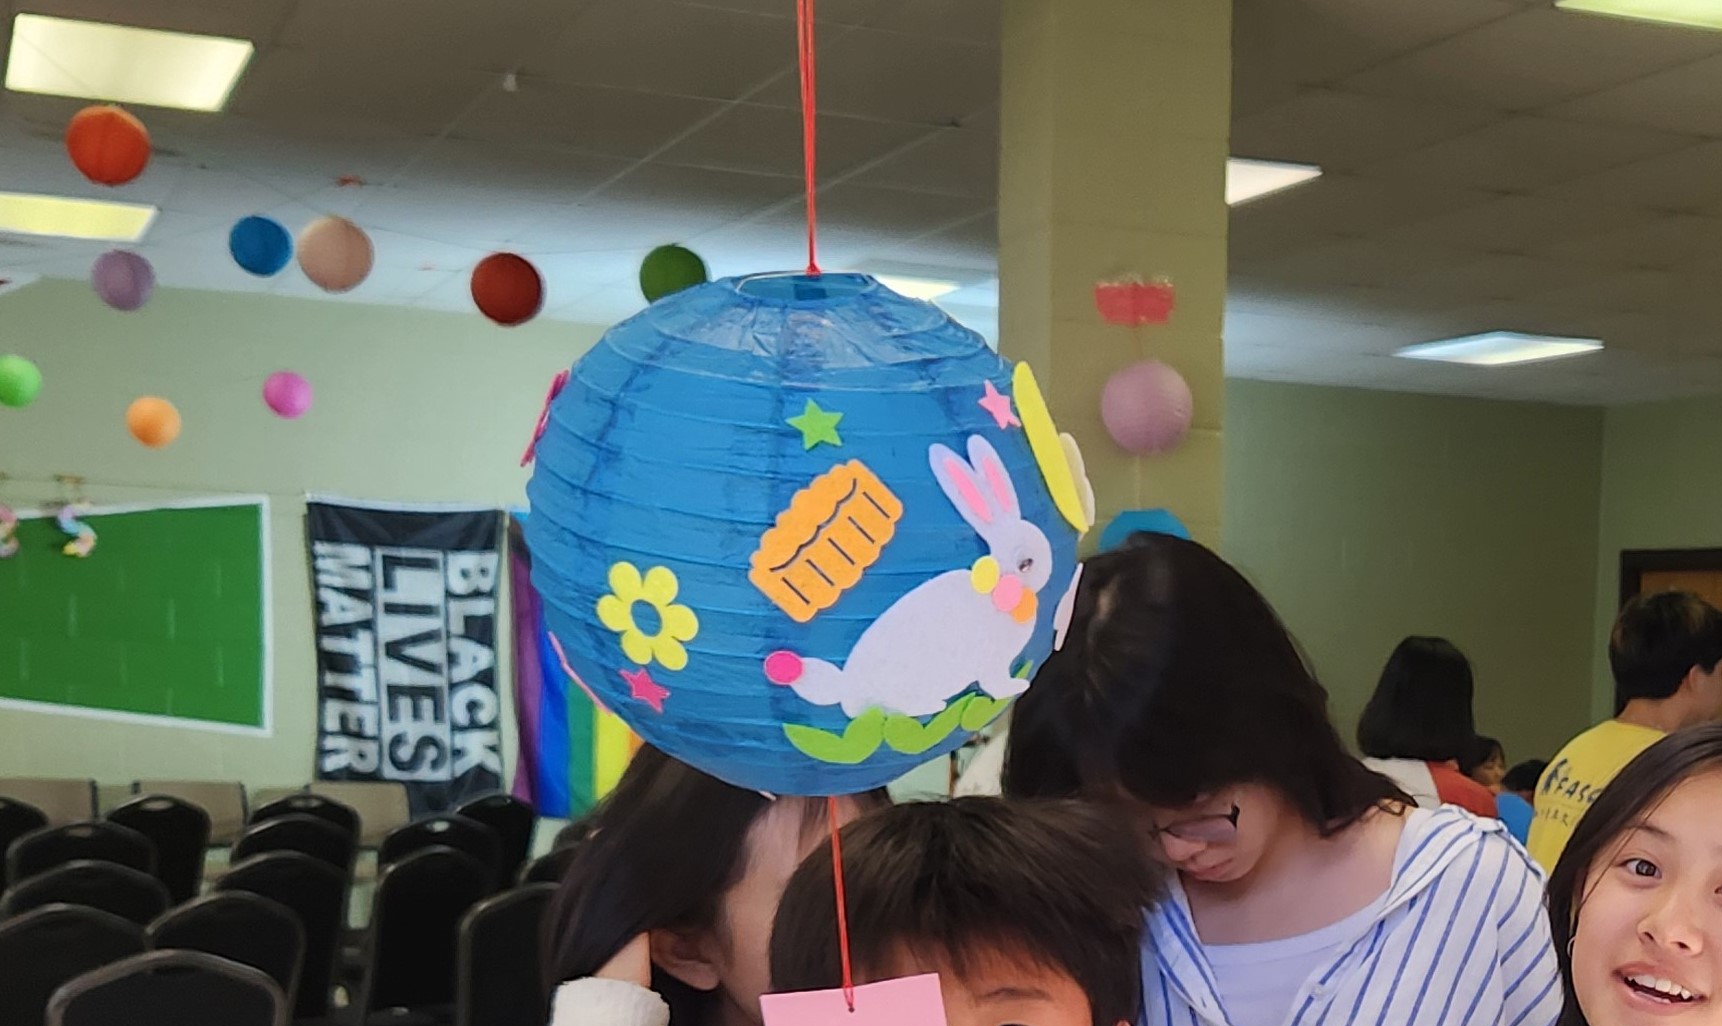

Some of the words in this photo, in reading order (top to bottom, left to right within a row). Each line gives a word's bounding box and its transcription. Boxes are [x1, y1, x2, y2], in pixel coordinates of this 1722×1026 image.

[313, 540, 379, 776] MATTER
[382, 554, 448, 775] LIVES
[446, 550, 500, 779] BLACK
